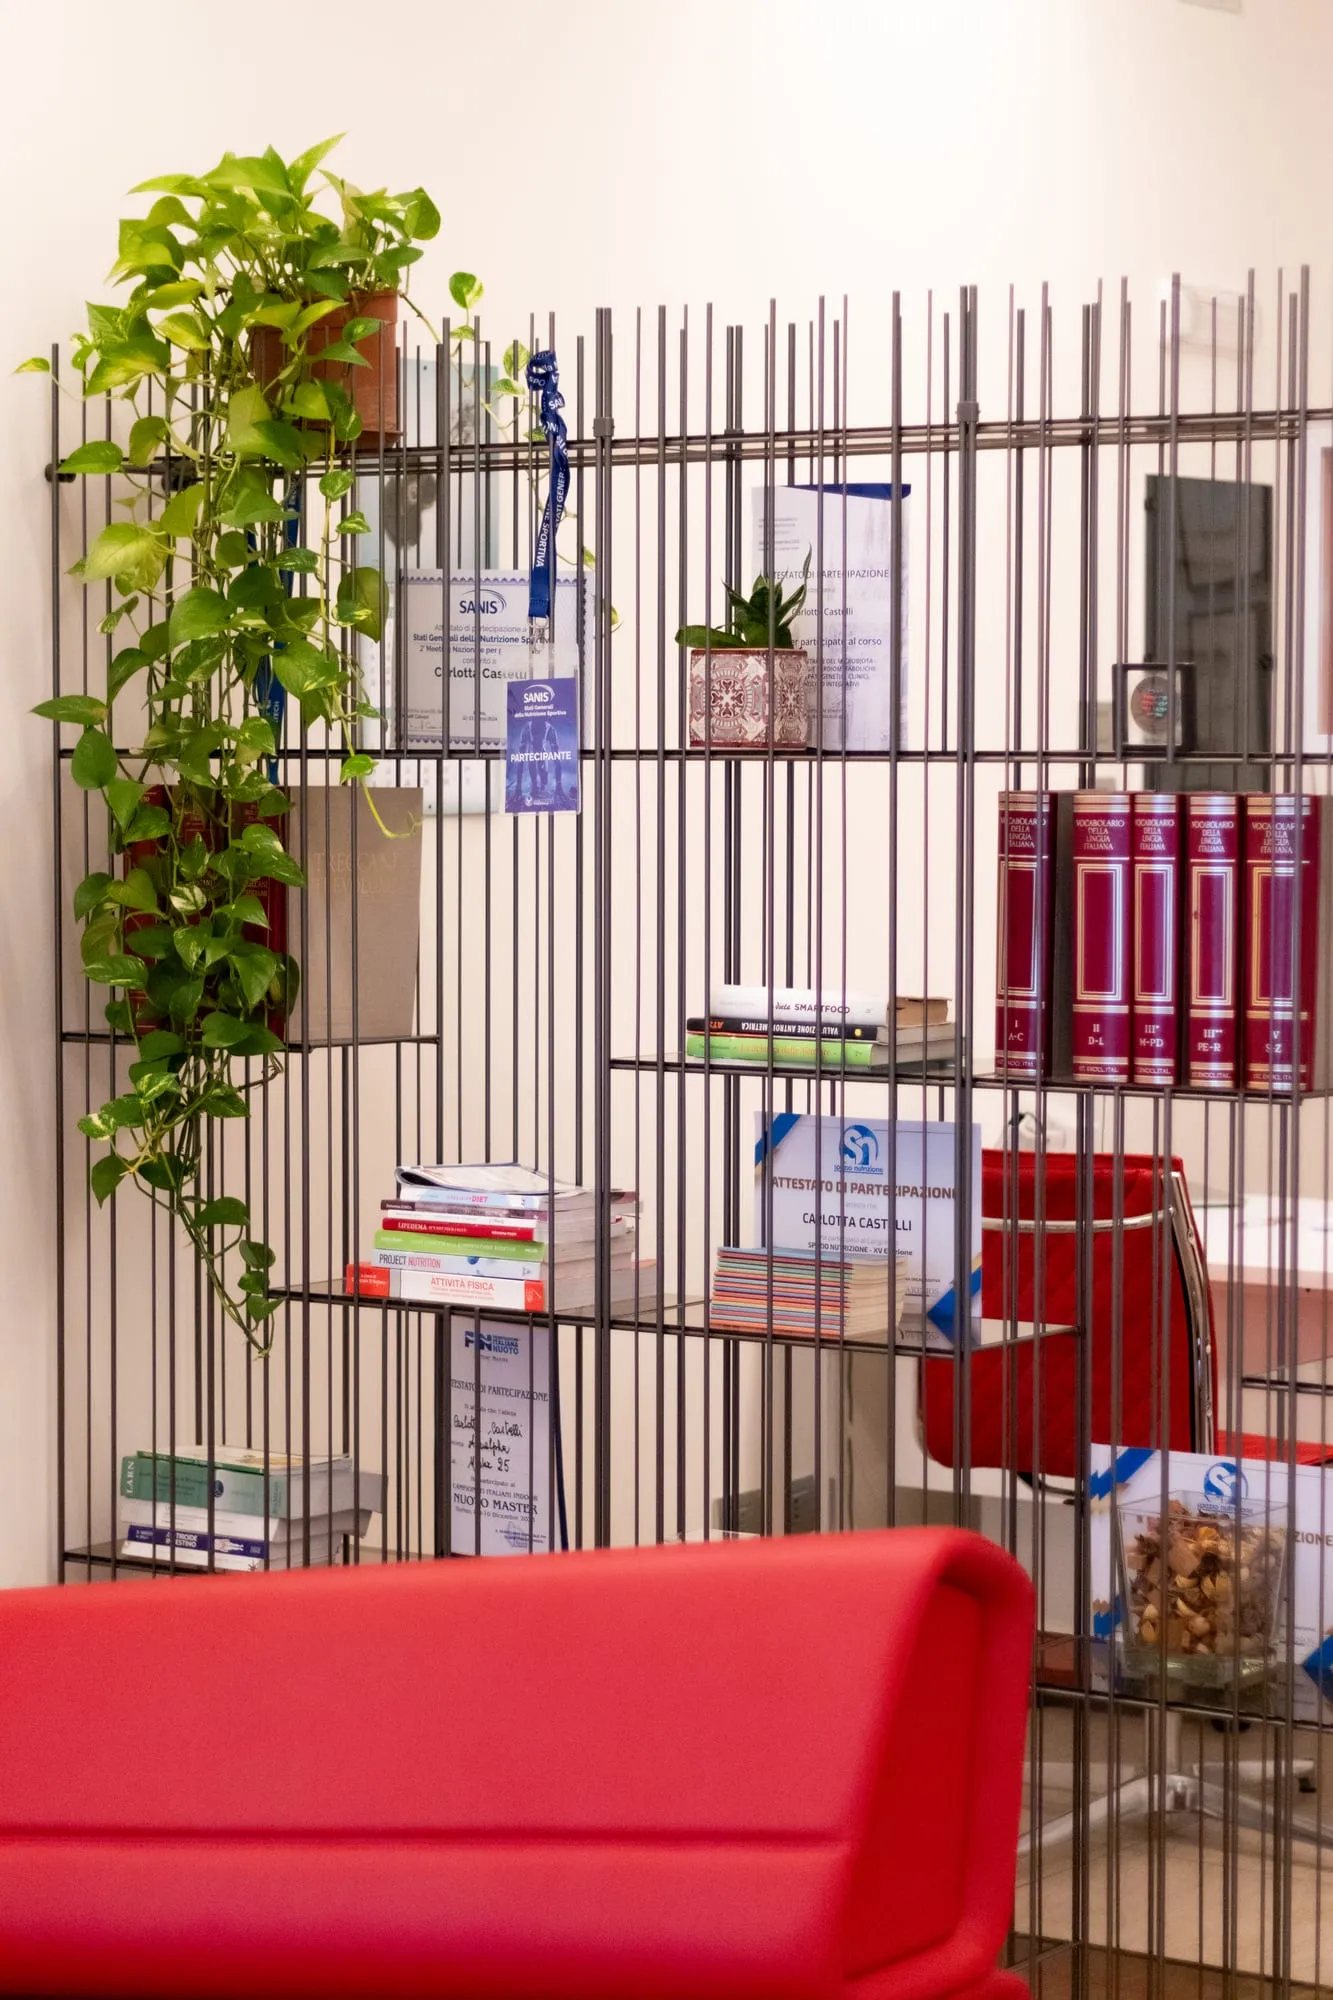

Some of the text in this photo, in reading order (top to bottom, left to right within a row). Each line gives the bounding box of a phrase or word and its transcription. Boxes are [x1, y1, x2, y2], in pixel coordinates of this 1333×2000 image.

[459, 600, 498, 614] SANIS
[428, 634, 458, 643] Genali
[858, 638, 882, 646] corso
[523, 692, 549, 704] SANIS
[510, 751, 572, 763] PARTECIPANTE
[1076, 819, 1126, 827] VOCABOLARIO
[1191, 821, 1235, 829] VOCABOLARIO
[1010, 825, 1031, 833] DELLA
[1088, 827, 1109, 835] DELLA
[1143, 827, 1162, 835] DELLA
[1202, 829, 1221, 837] DELLA
[1086, 835, 1111, 843] LINGUA
[1201, 837, 1222, 845] LINGUA
[1083, 842, 1114, 850] ITALIANA
[1198, 845, 1226, 853] ITALIANA
[1092, 1023, 1100, 1033] II
[1008, 1032, 1024, 1042] A-C
[1088, 1036, 1104, 1046] D-L
[1197, 1042, 1221, 1052] PE-R
[854, 1165, 883, 1173] nutrizione
[836, 1181, 847, 1192] DI
[472, 1195, 489, 1204] DIET
[398, 1222, 427, 1231] LIPEDEMA
[859, 1217, 912, 1231] CASTLLI
[379, 1253, 441, 1269] PROJECT NUTRITION
[431, 1276, 494, 1291] ATTIVITÀ FISICA
[492, 1346, 519, 1355] NUOTO
[488, 1386, 549, 1401] PARTECIPAZONE
[498, 1456, 510, 1472] 25
